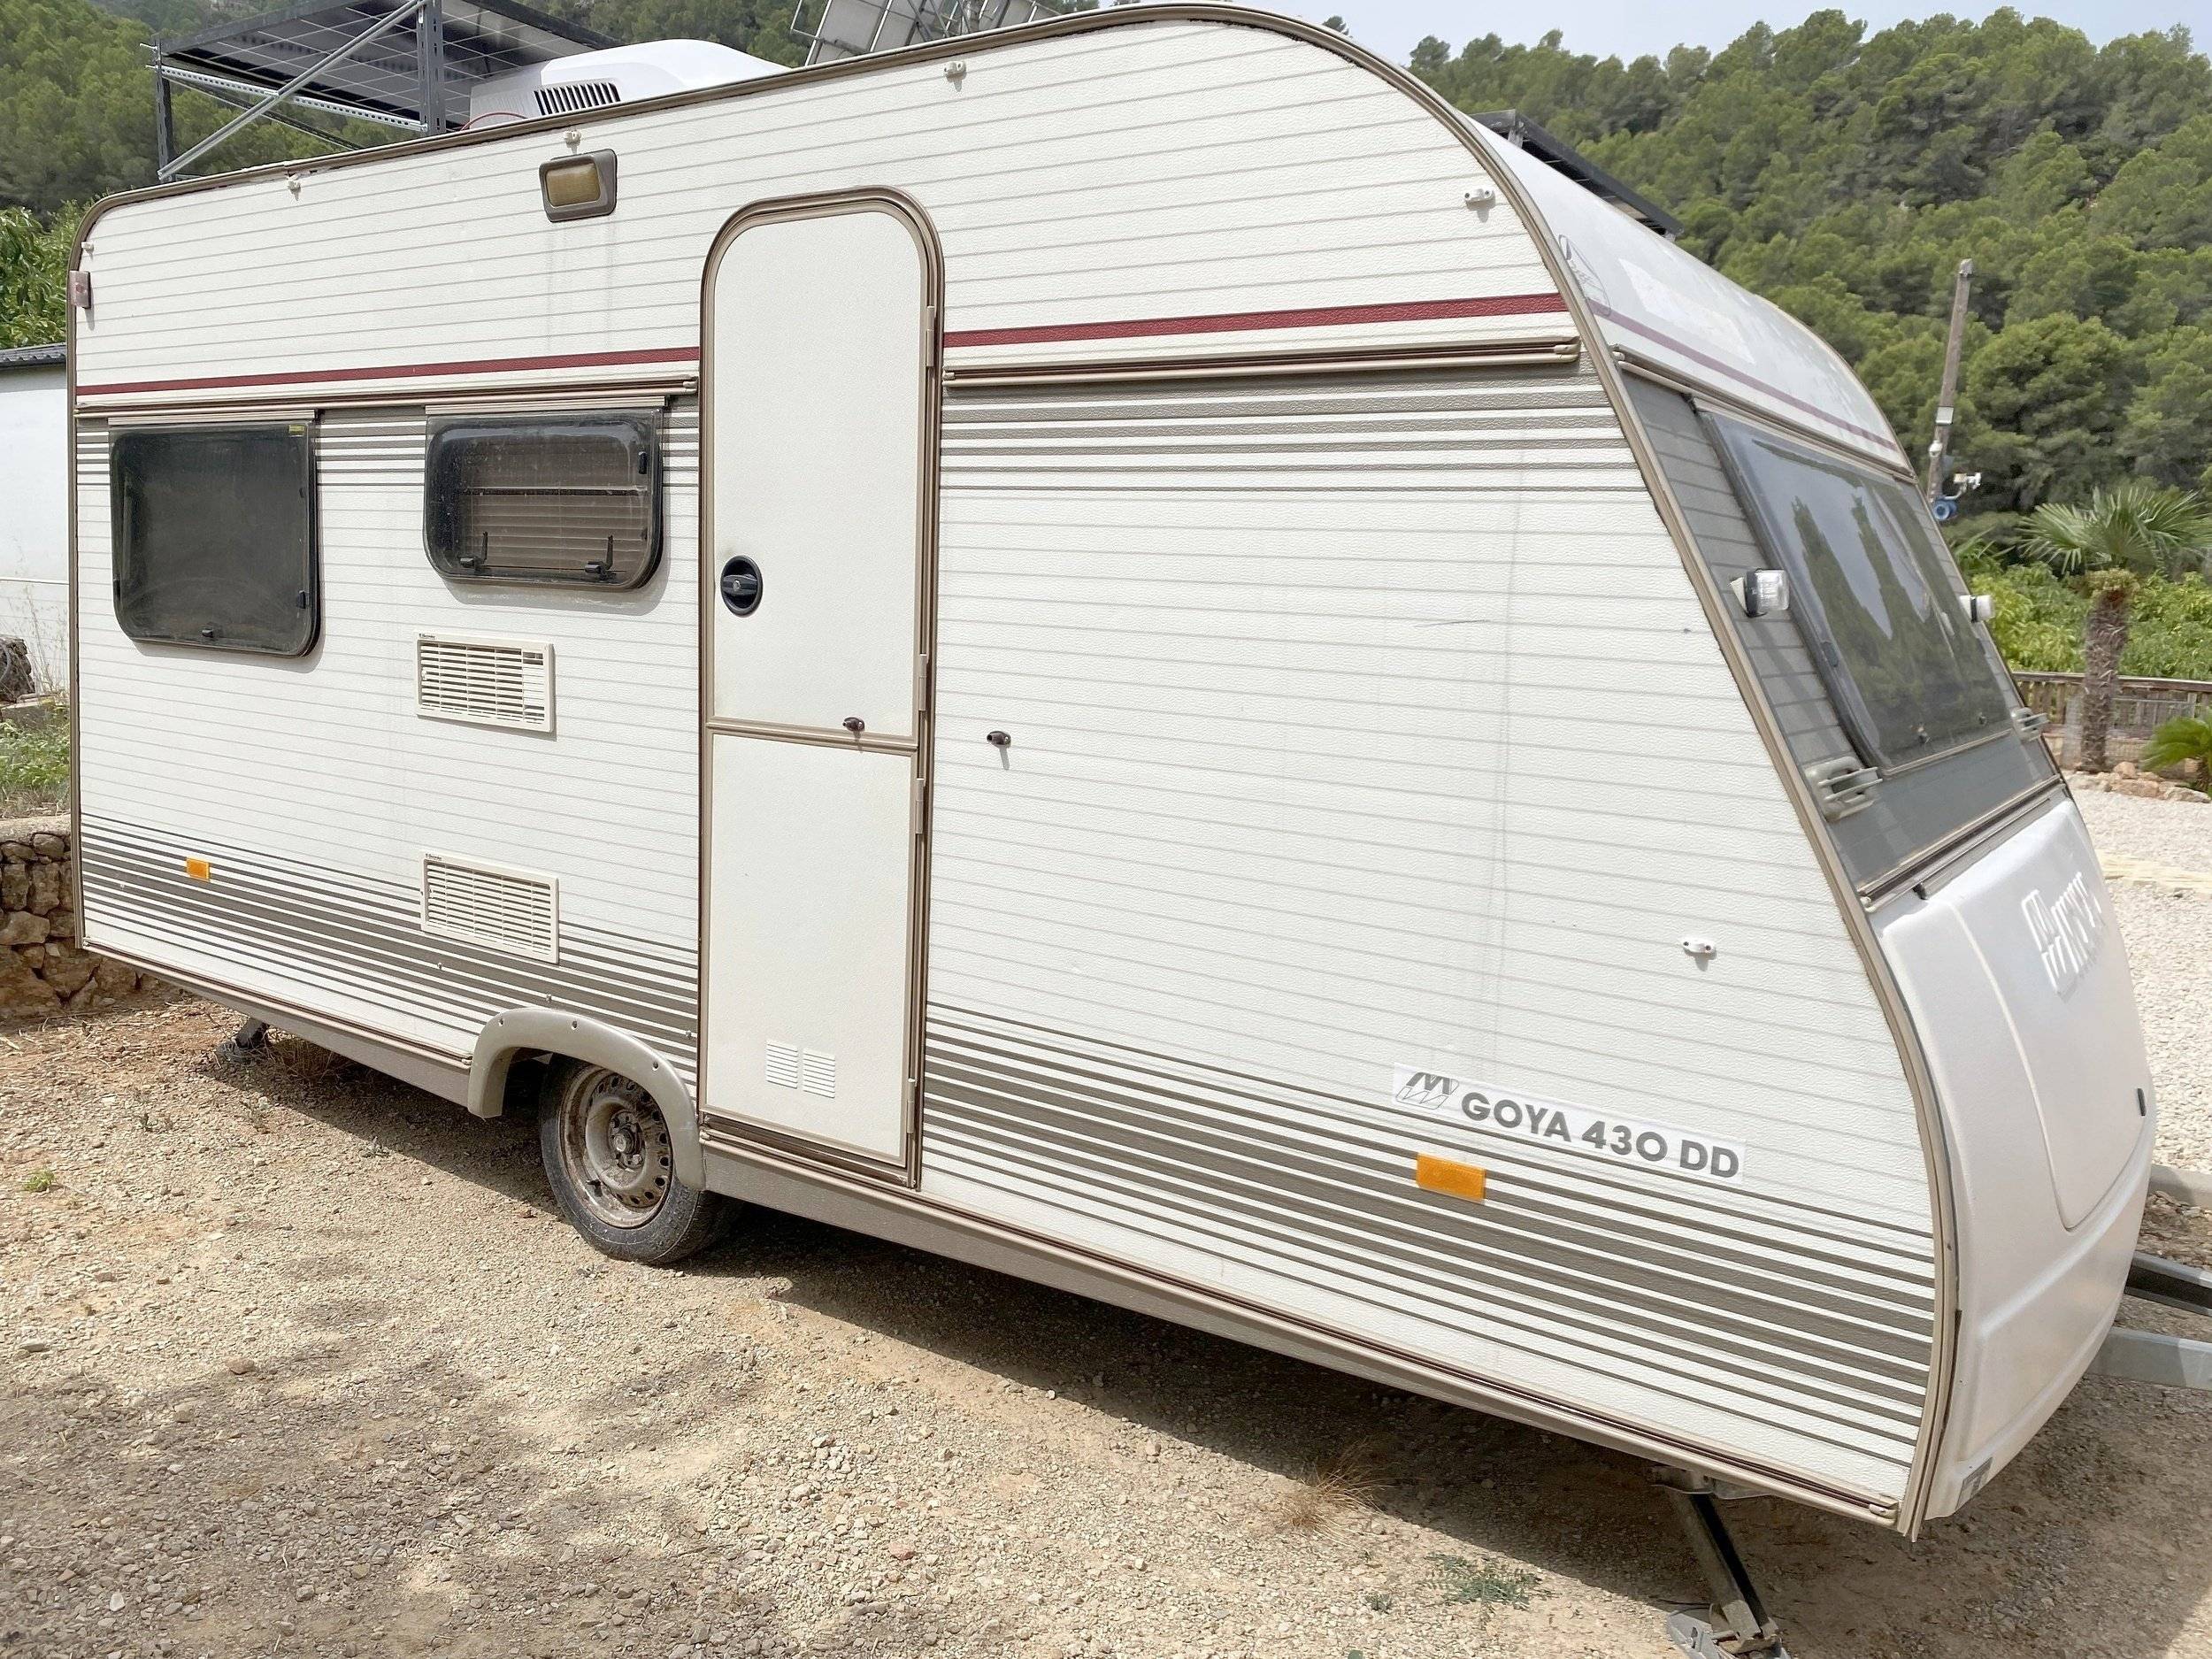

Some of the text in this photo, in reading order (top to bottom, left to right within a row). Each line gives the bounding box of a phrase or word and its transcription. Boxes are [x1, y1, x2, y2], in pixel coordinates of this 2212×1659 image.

[1461, 1092, 1572, 1142] GOYA
[1581, 1120, 1668, 1162] 430
[1680, 1139, 1740, 1179] DD
